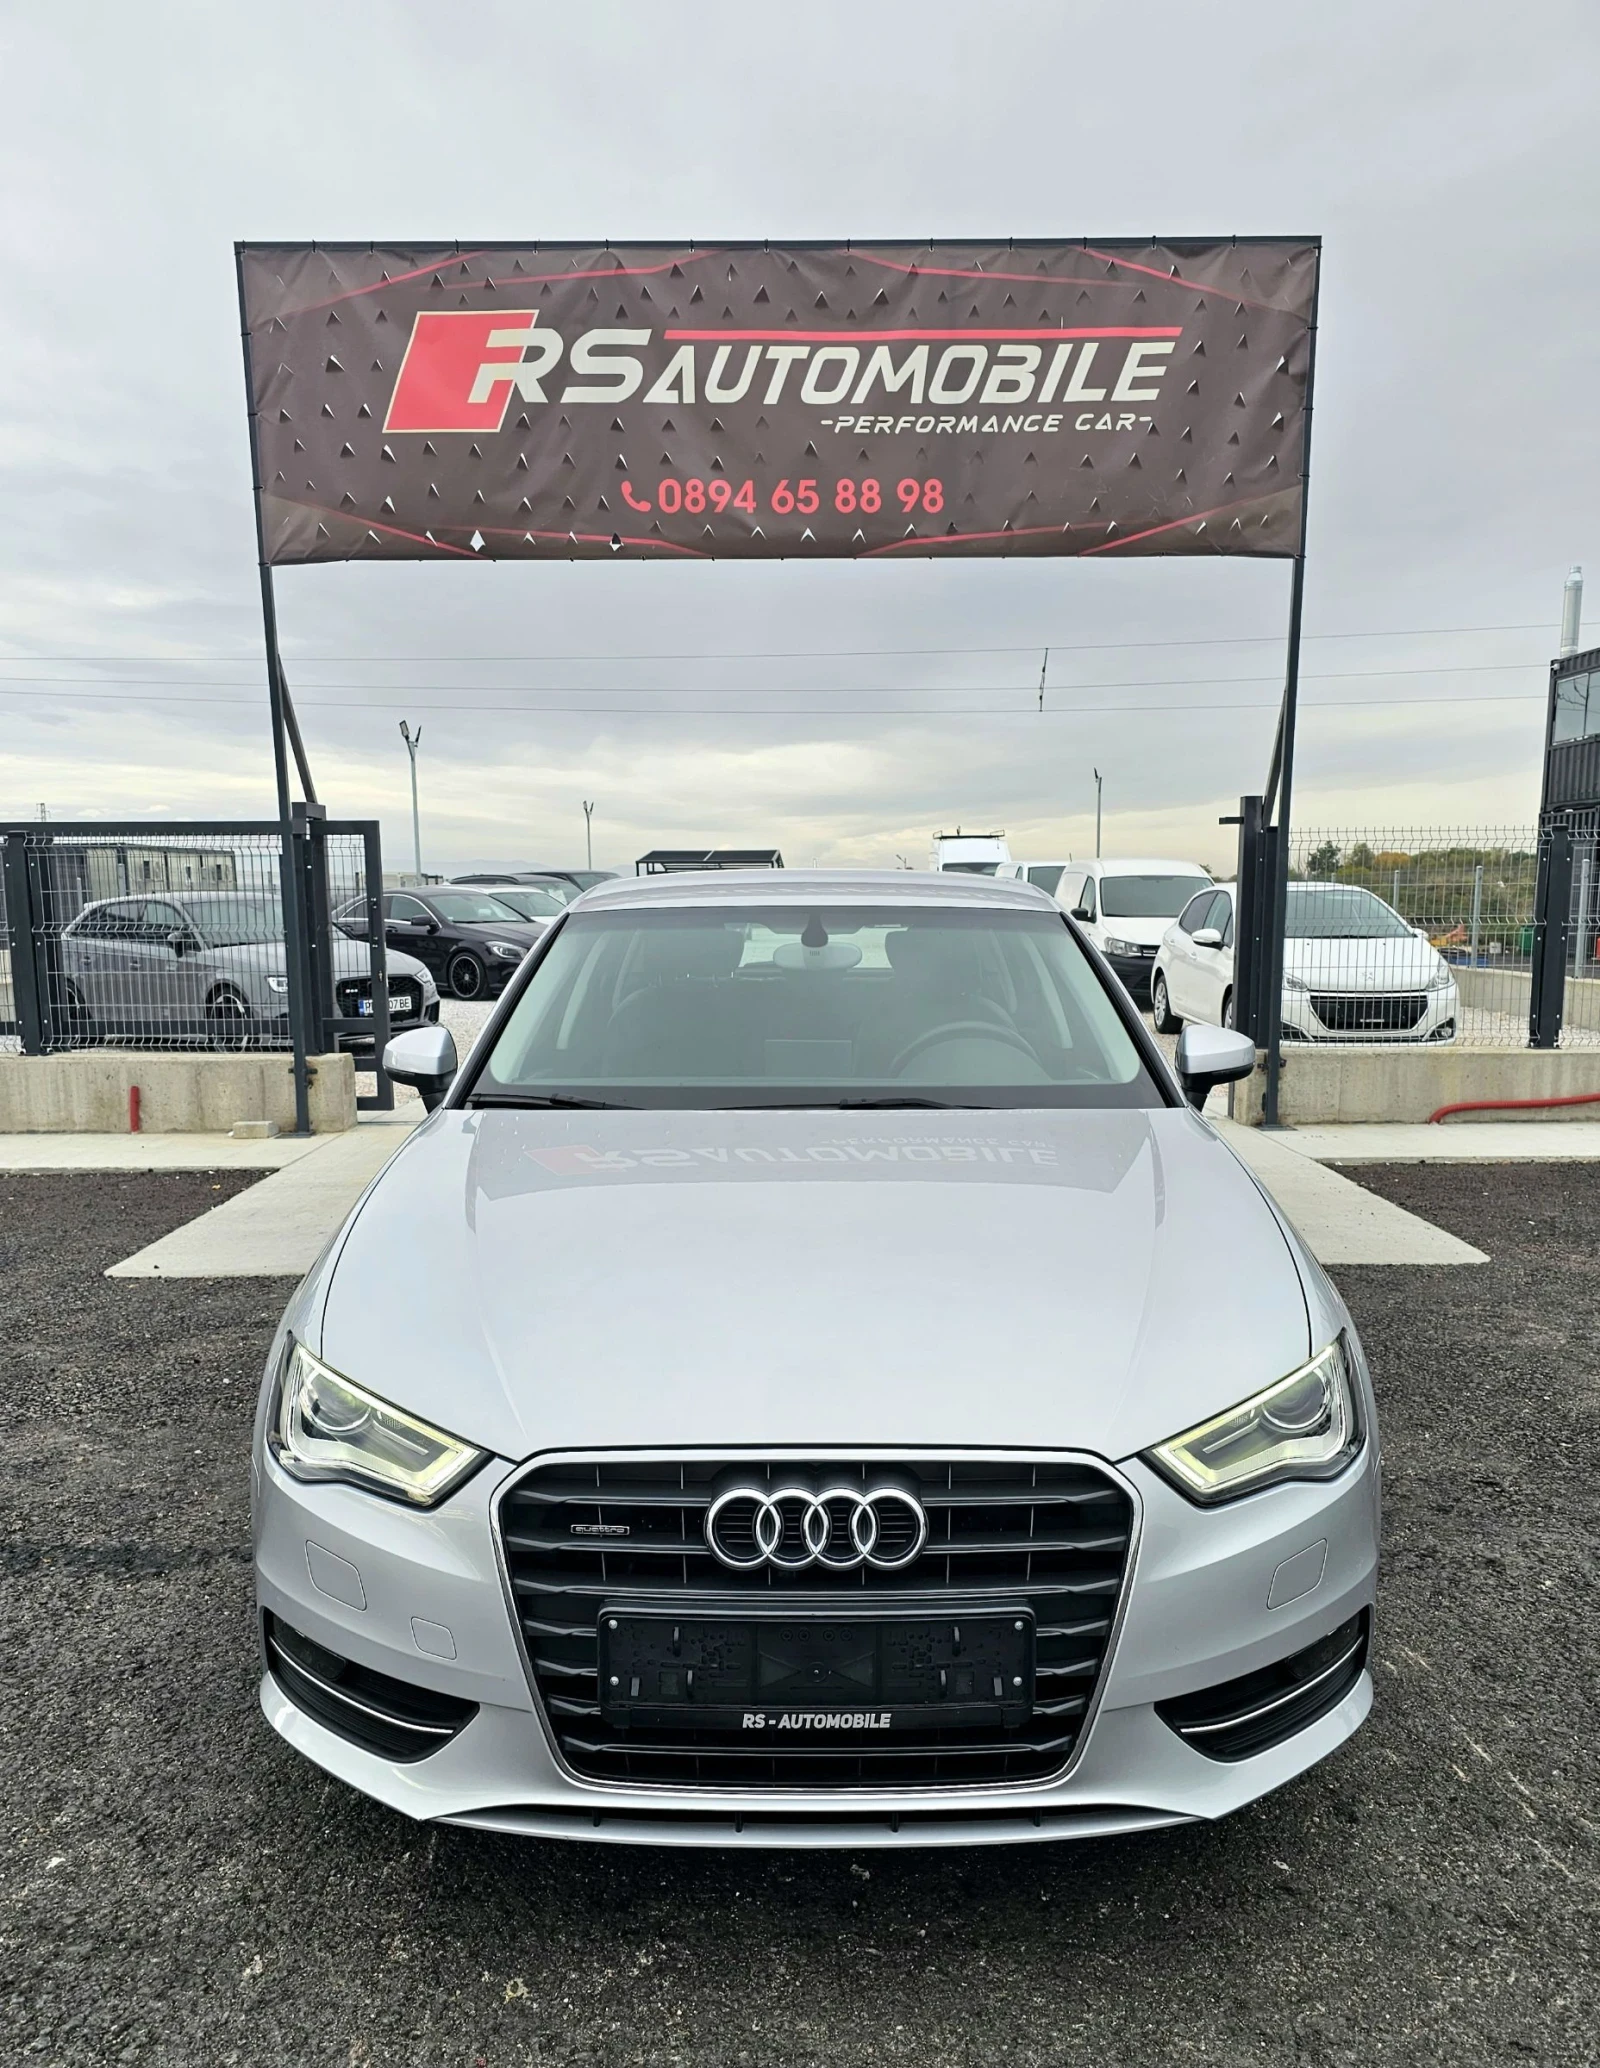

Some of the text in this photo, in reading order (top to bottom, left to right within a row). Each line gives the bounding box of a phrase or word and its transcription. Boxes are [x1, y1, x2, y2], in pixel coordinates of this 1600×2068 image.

[658, 478, 944, 514] 0894 65 88 98
[575, 1526, 625, 1534] quattro
[742, 1713, 766, 1729] RS
[777, 1713, 892, 1729] AUTOMOBILE
